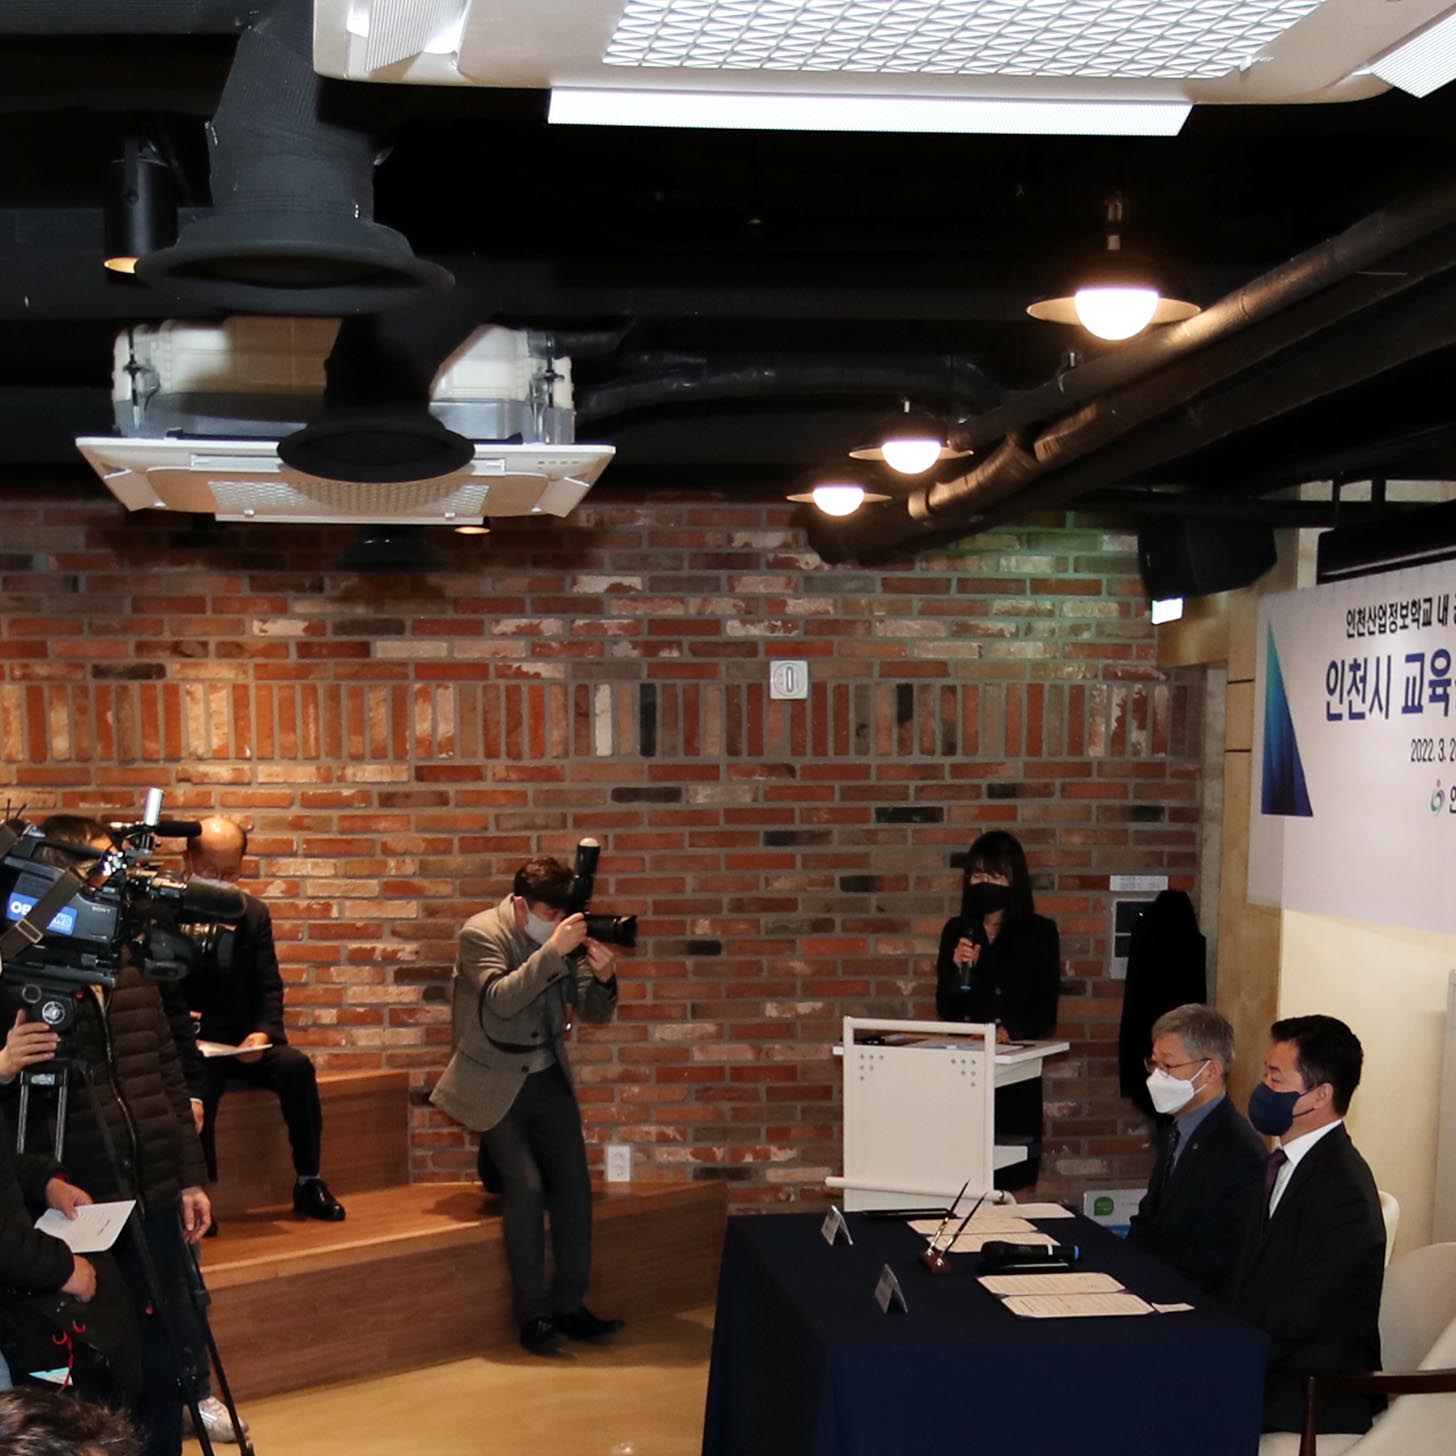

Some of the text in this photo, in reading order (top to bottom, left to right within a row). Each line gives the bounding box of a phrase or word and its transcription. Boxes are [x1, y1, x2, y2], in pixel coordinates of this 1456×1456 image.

[1346, 597, 1432, 638] 인천산업정보학교
[1437, 594, 1449, 627] 내
[1326, 654, 1392, 722] 인천시
[10, 901, 32, 916] OB
